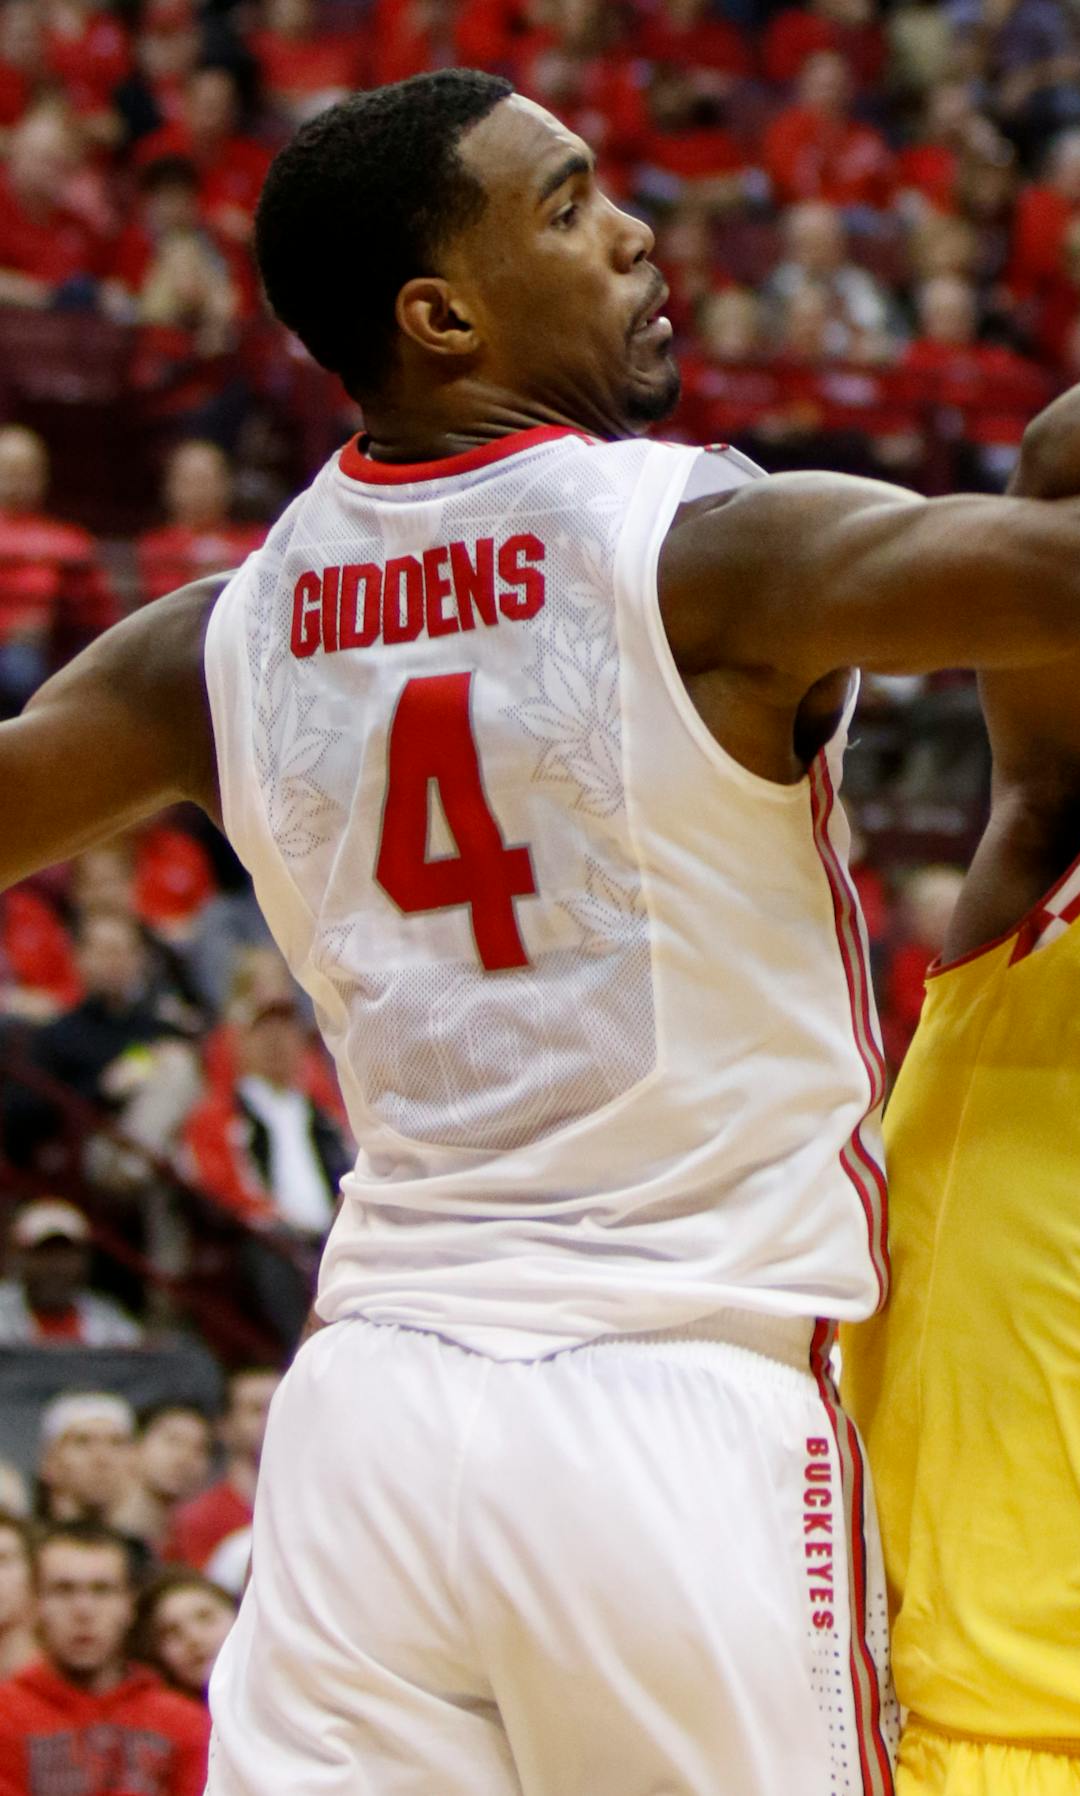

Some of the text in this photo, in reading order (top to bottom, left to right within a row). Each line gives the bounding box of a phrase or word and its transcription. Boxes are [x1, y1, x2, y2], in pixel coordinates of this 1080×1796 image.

[290, 533, 545, 659] GIDDENS
[372, 669, 538, 972] 4
[803, 1437, 834, 1630] BUCKEYES
